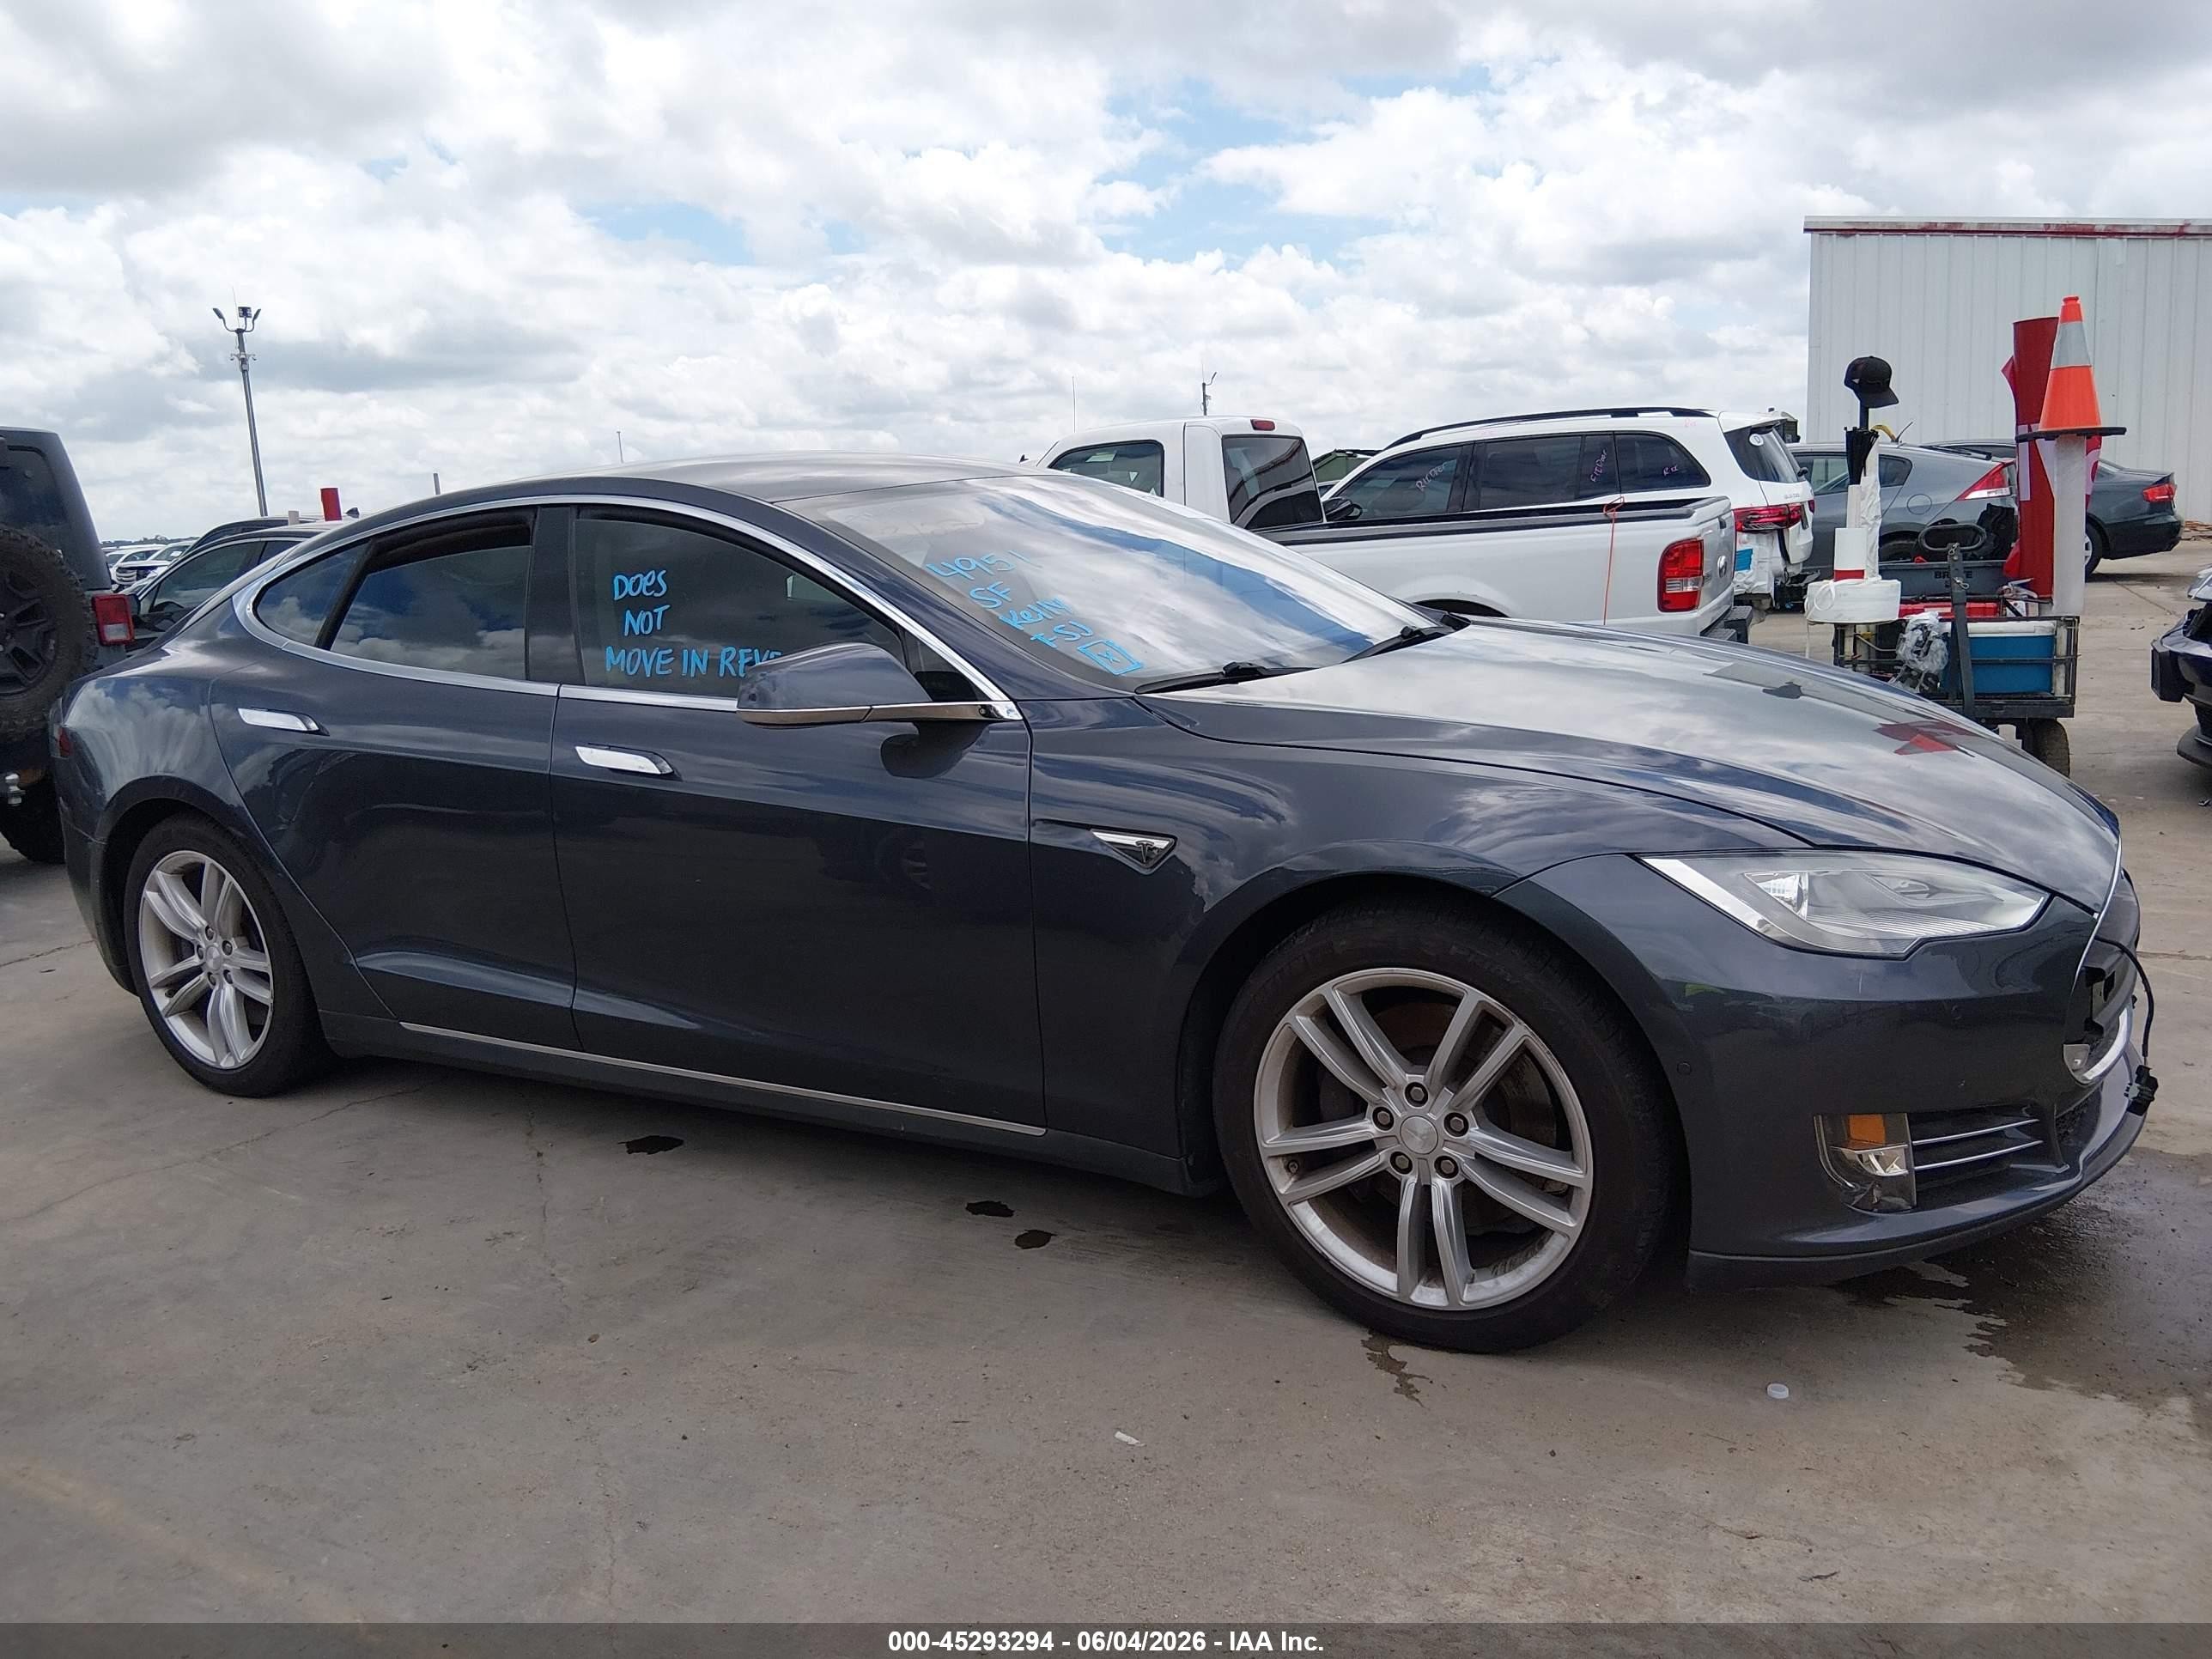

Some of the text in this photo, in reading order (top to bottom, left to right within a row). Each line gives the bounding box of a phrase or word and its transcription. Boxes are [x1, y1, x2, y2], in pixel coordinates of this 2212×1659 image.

[926, 550, 1038, 580] 4951
[969, 581, 1012, 609] SF
[624, 605, 671, 636] NOT
[605, 646, 675, 678] MOVE
[682, 649, 708, 678] IN
